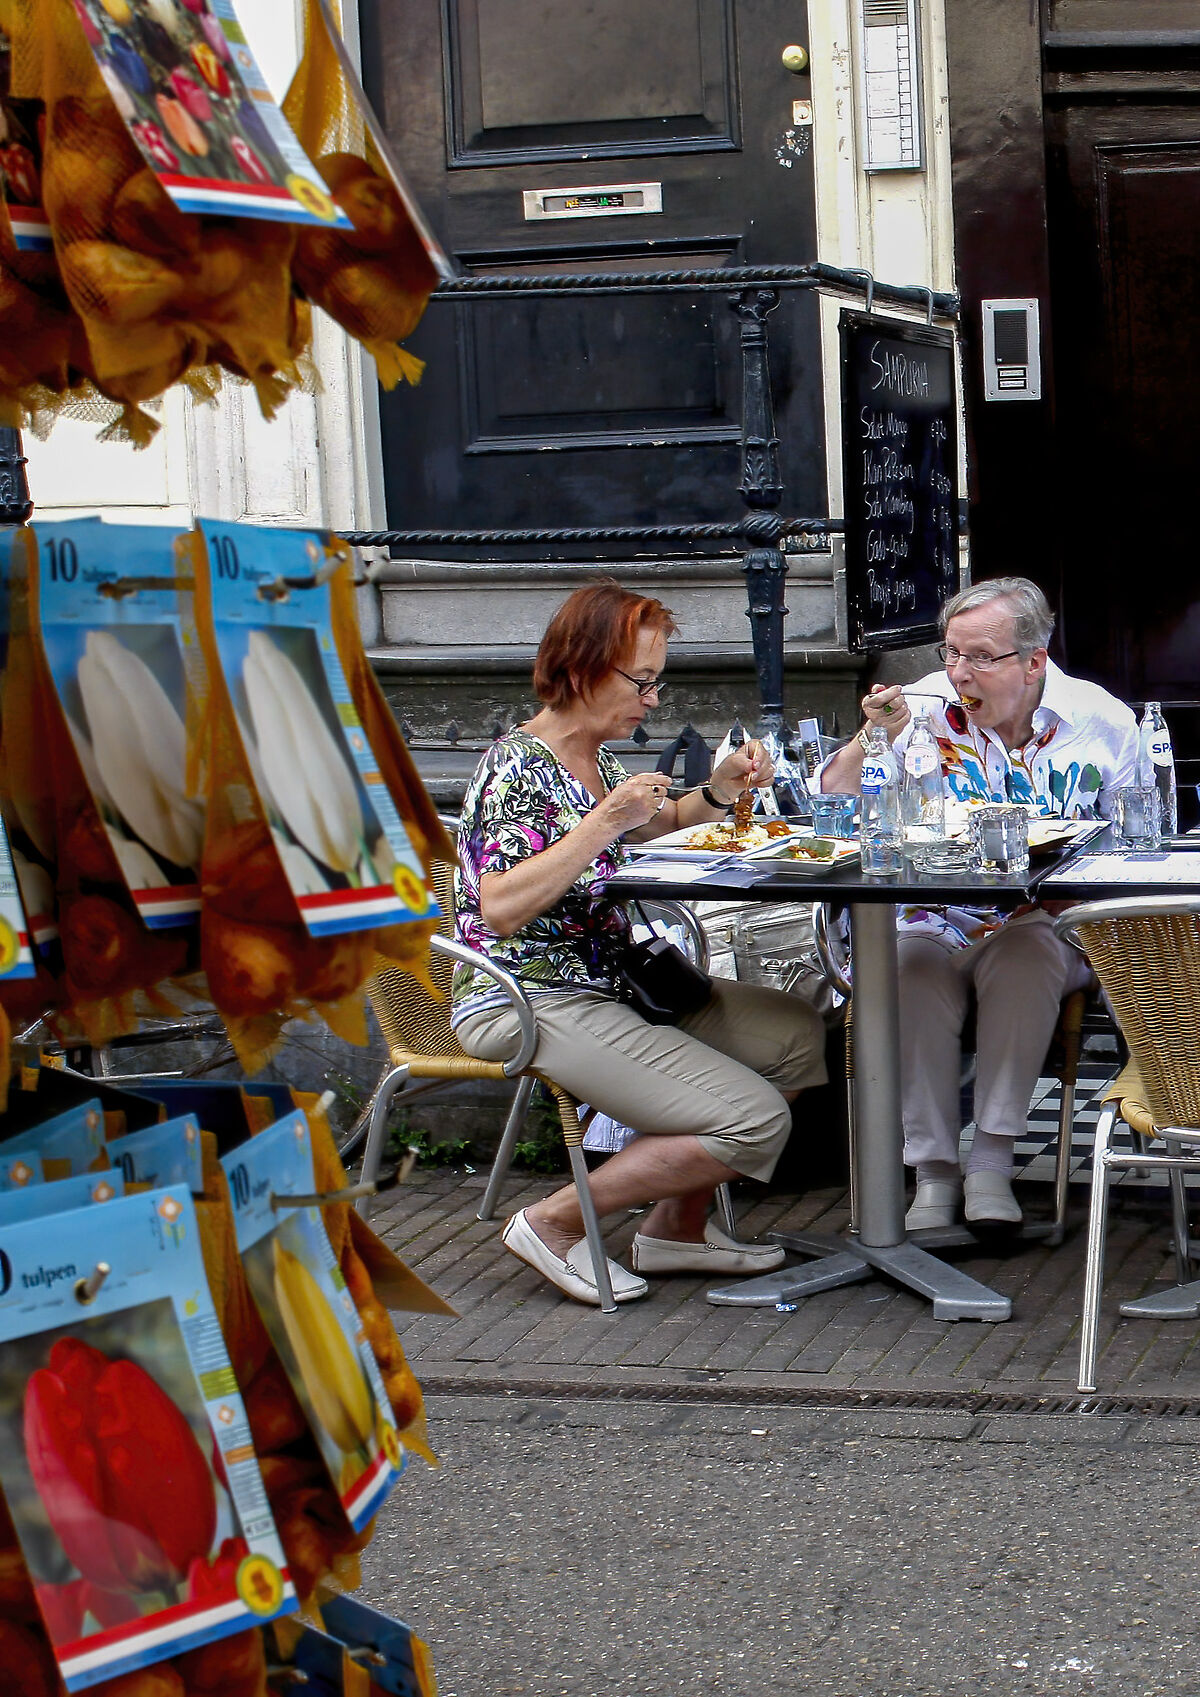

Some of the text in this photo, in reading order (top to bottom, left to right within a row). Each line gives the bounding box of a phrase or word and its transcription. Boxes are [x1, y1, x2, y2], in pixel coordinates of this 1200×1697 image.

[870, 340, 929, 397] SAMPURNA
[44, 537, 78, 582] 10
[210, 535, 239, 580] 10
[861, 766, 887, 780] SPA
[230, 1163, 250, 1210] 10
[22, 1264, 77, 1289] tulpen
